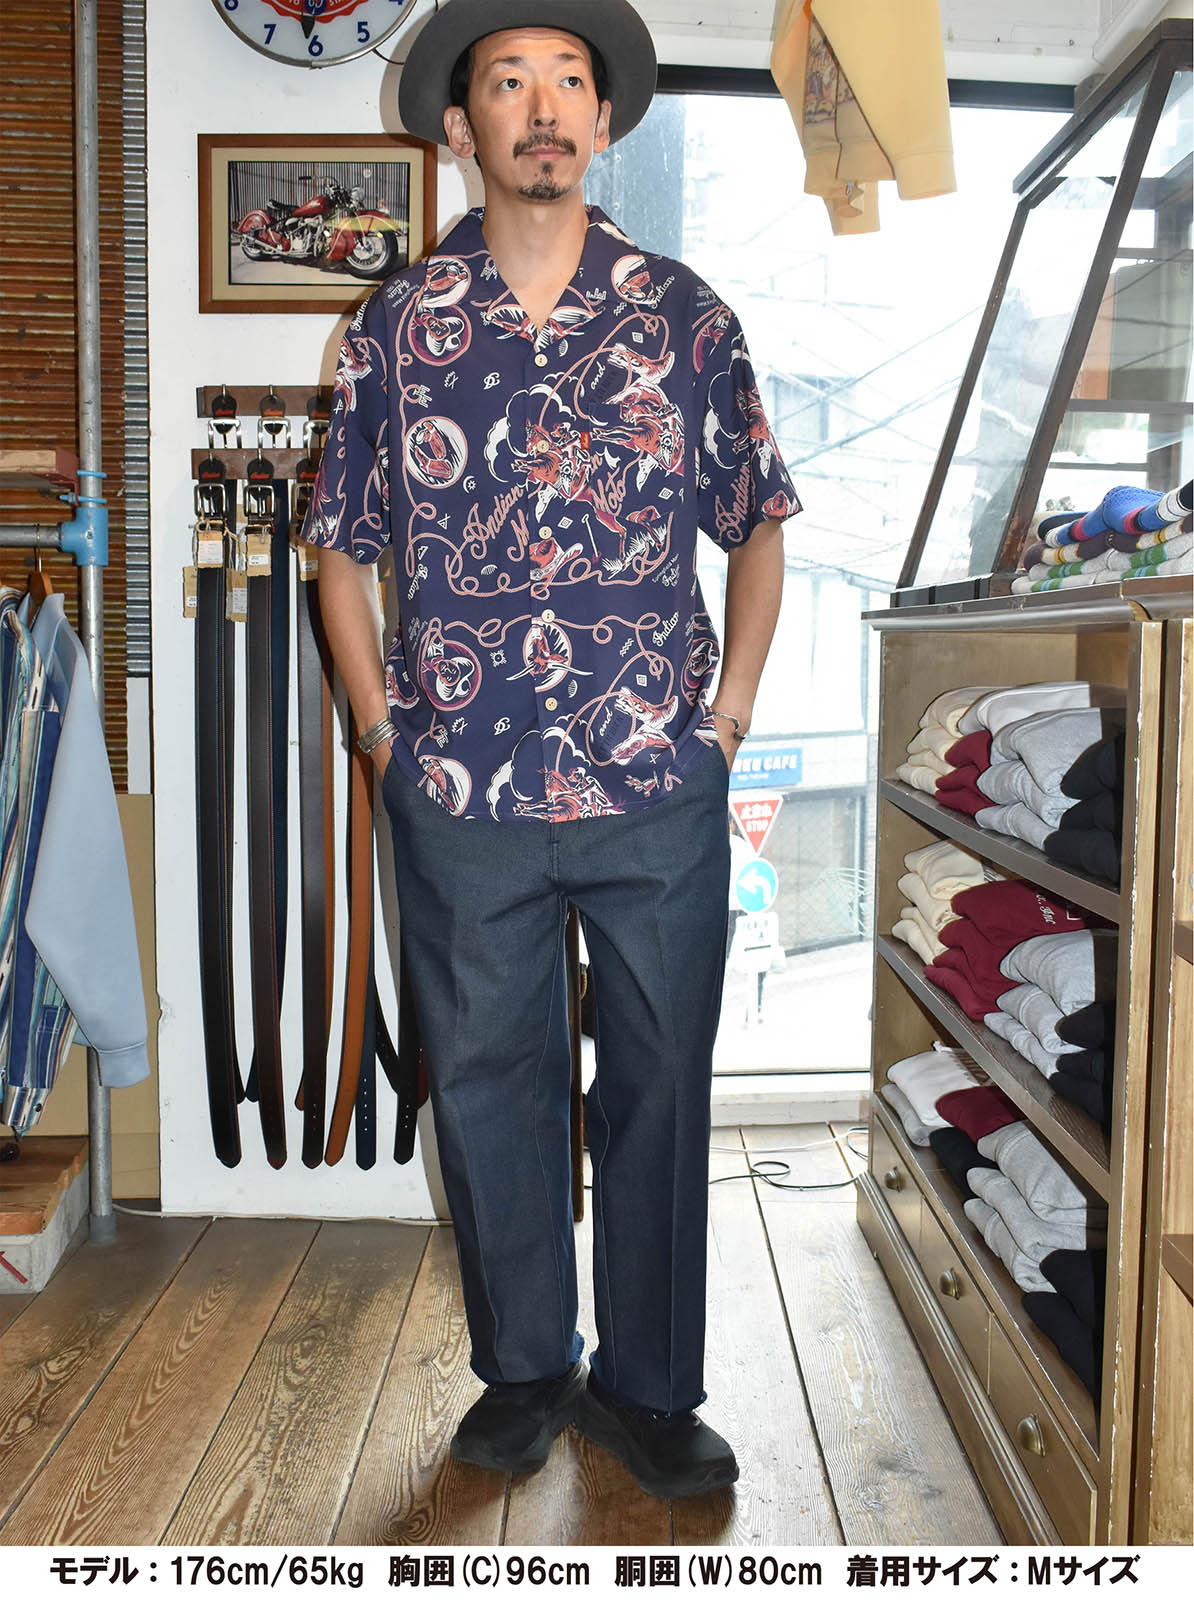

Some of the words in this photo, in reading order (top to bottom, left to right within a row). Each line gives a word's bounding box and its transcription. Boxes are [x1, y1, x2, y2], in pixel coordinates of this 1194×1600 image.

[263, 24, 277, 45] 7
[357, 21, 370, 43] 5
[308, 35, 324, 57] 6
[591, 361, 606, 390] and
[715, 465, 751, 542] Indian
[463, 485, 524, 559] Indian
[599, 706, 613, 736] and
[763, 754, 798, 772] CAFE
[746, 819, 769, 832] STOP
